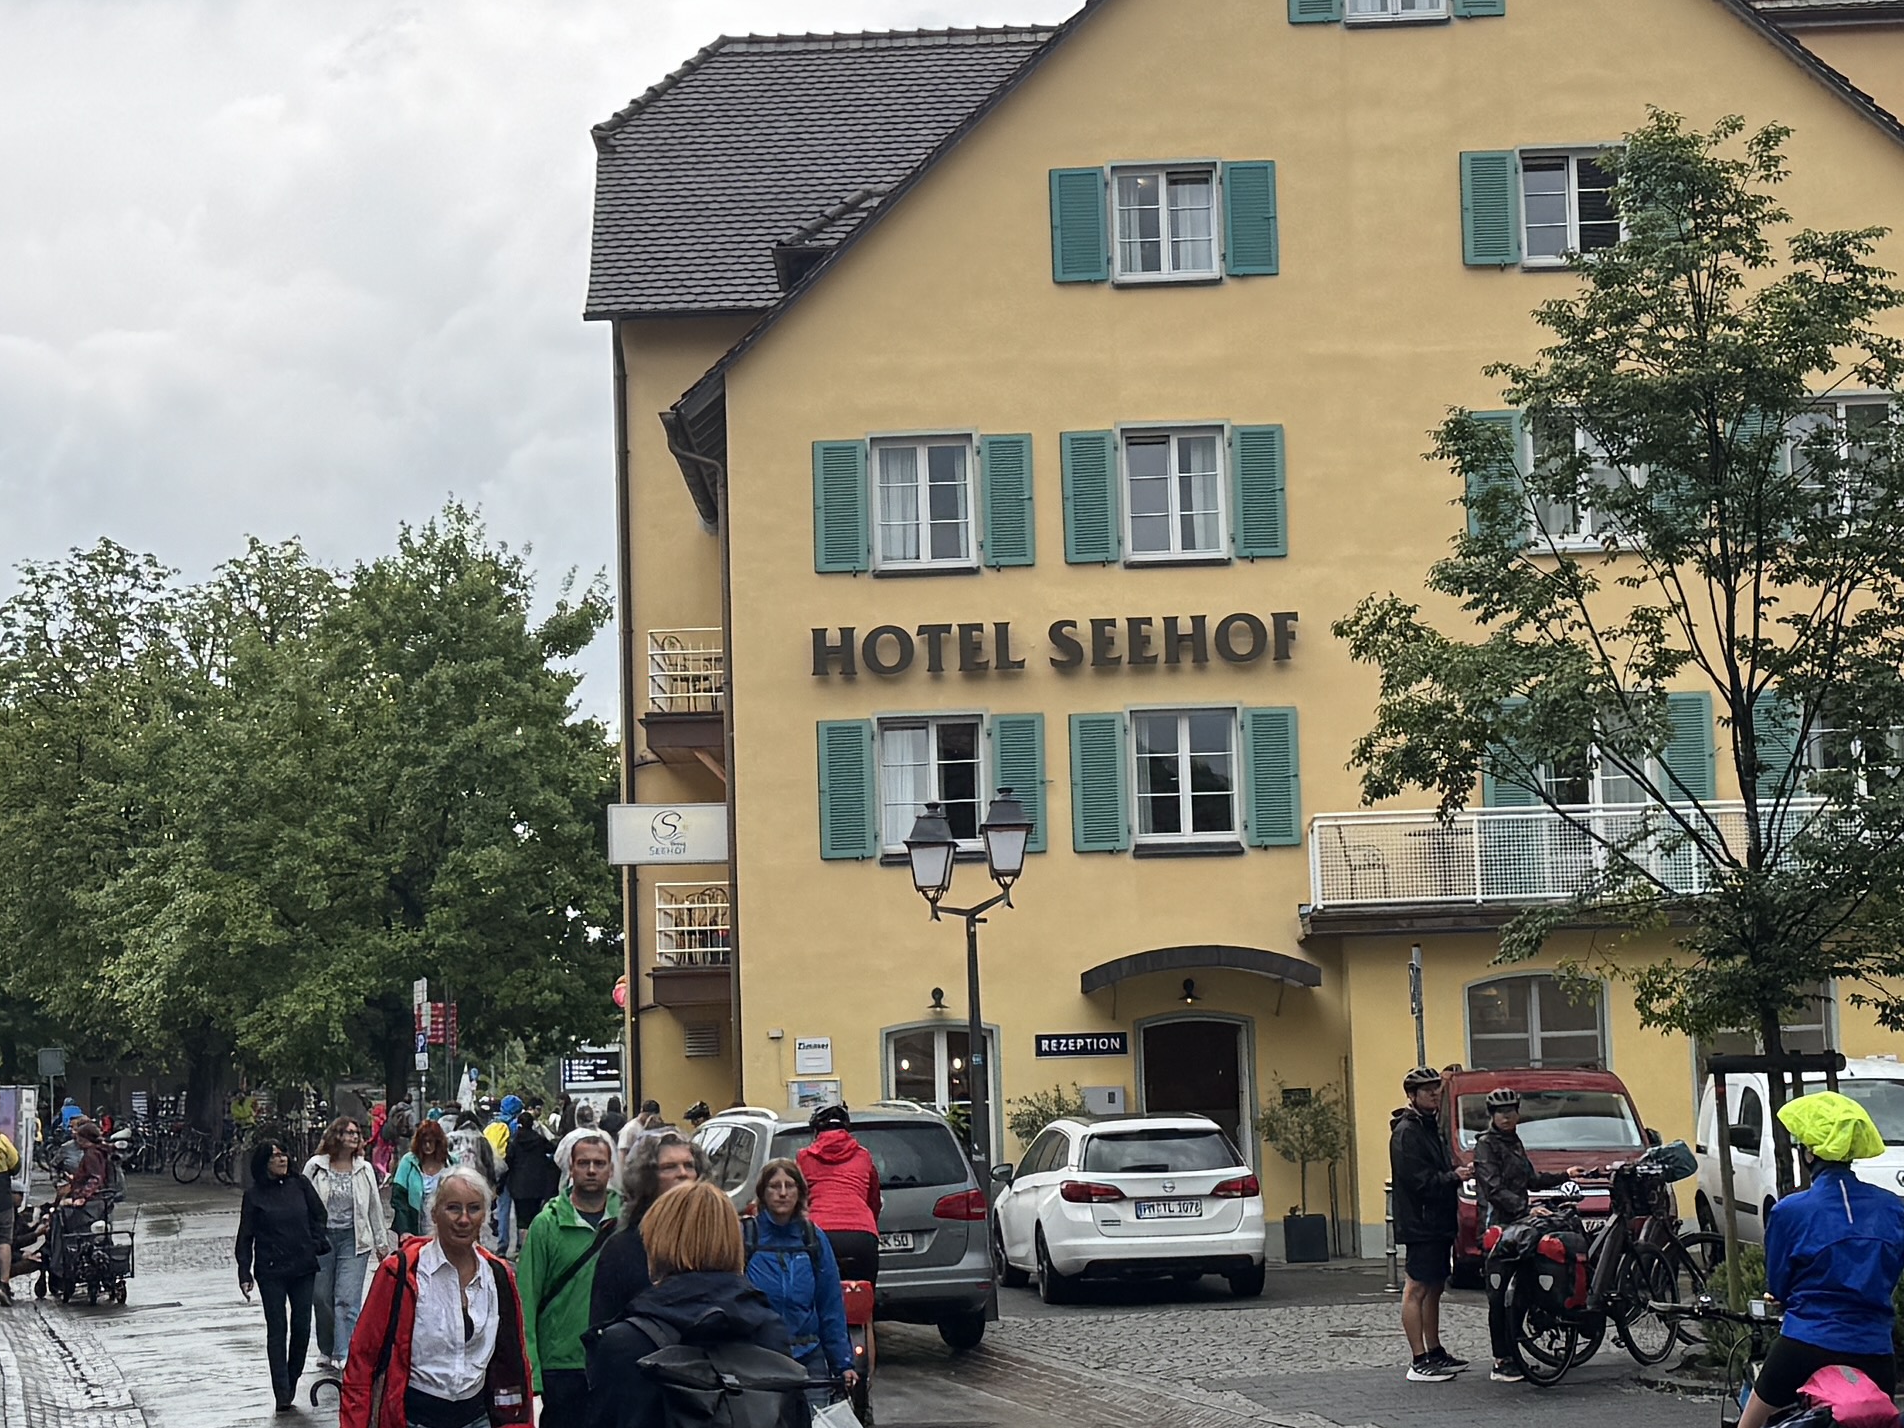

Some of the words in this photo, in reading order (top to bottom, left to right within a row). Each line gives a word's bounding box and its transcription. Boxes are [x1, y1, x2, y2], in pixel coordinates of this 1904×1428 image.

[811, 622, 1026, 676] HOTEL
[1048, 609, 1299, 669] SEEHOF
[1041, 1037, 1120, 1052] REZEPTION
